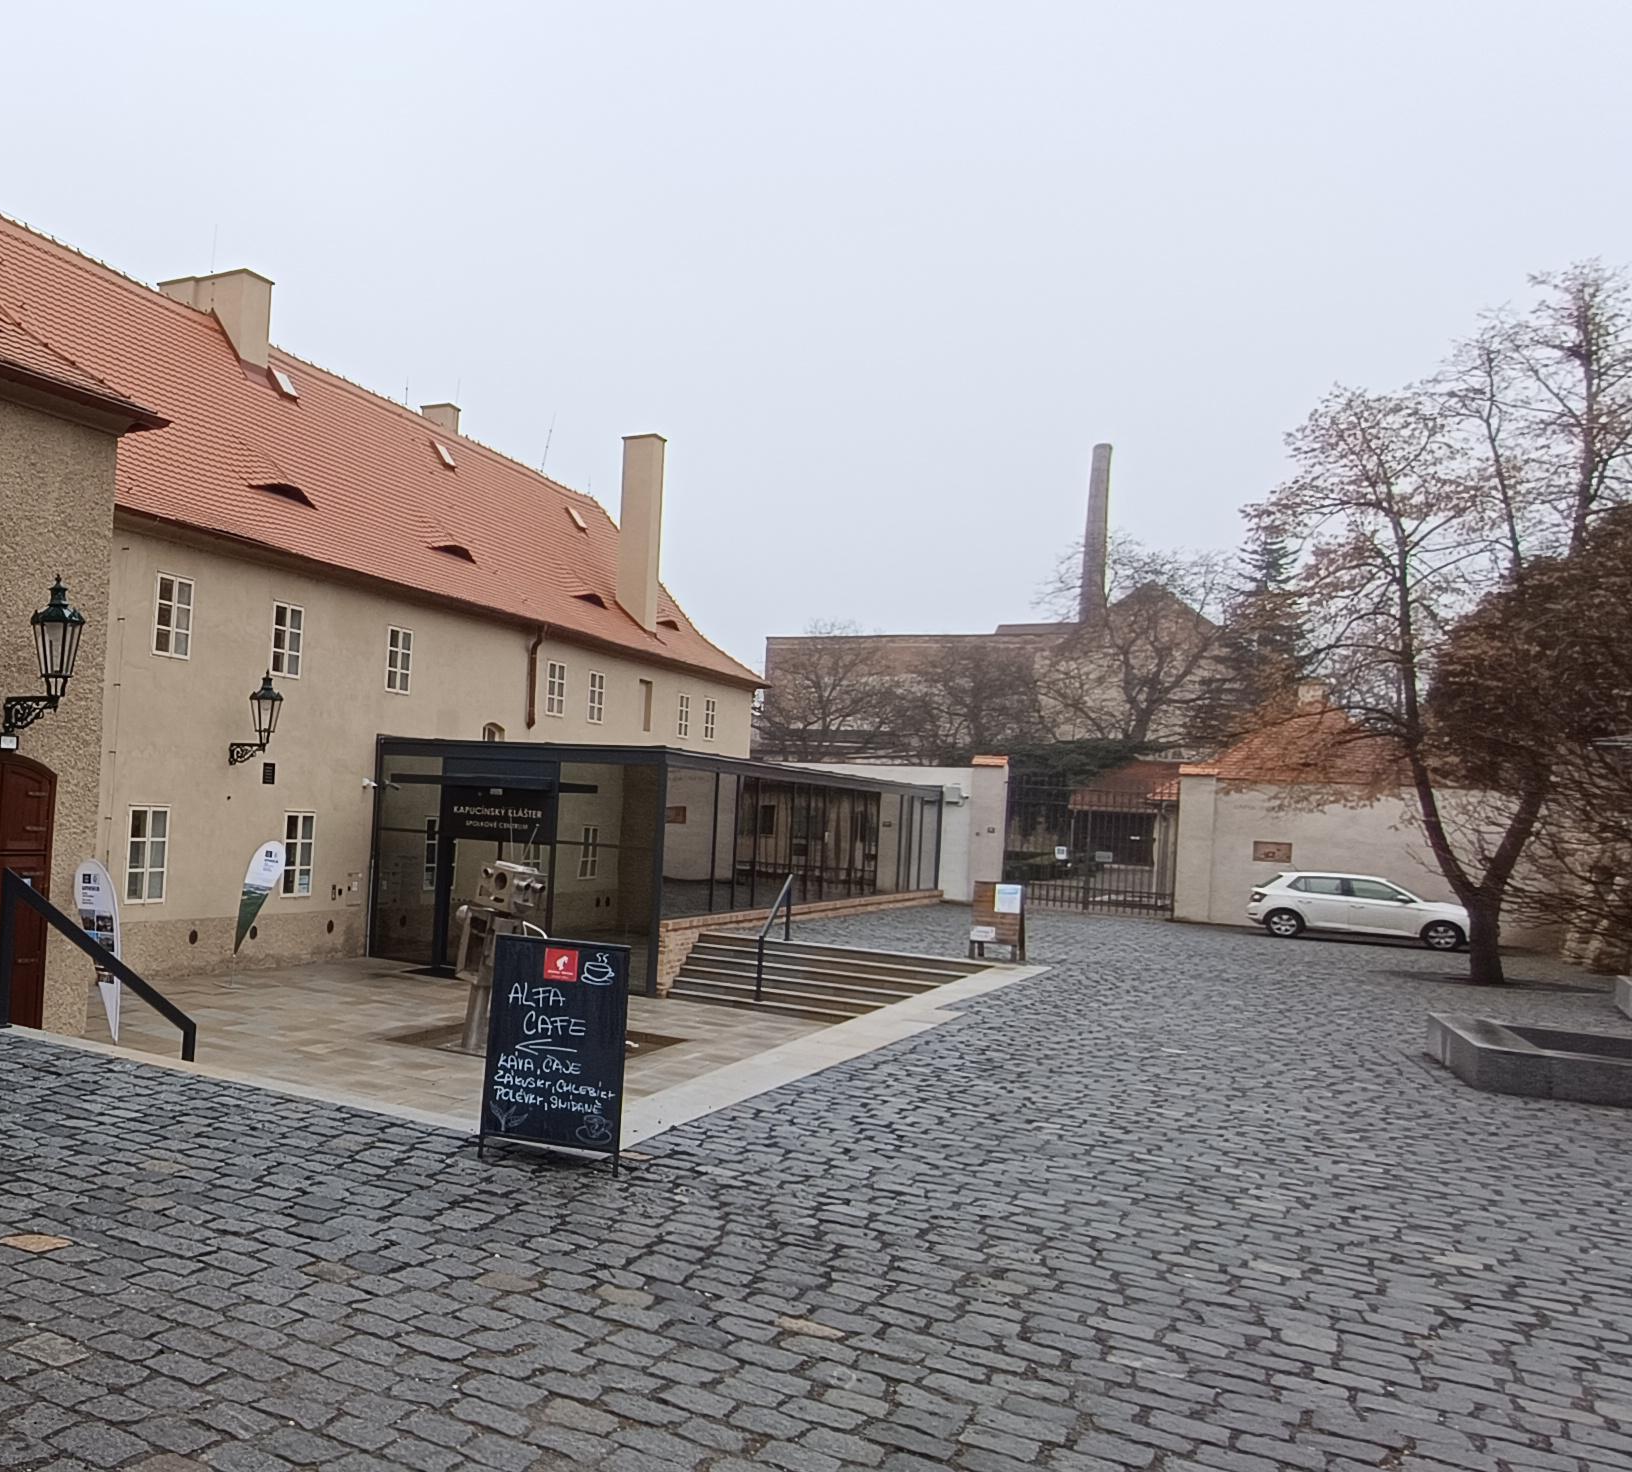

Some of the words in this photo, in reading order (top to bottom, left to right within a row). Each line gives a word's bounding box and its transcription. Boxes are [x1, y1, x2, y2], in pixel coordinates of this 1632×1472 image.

[508, 808, 542, 818] KLÁŠTER
[508, 982, 566, 1007] ALFA
[523, 1010, 586, 1036] CAFE
